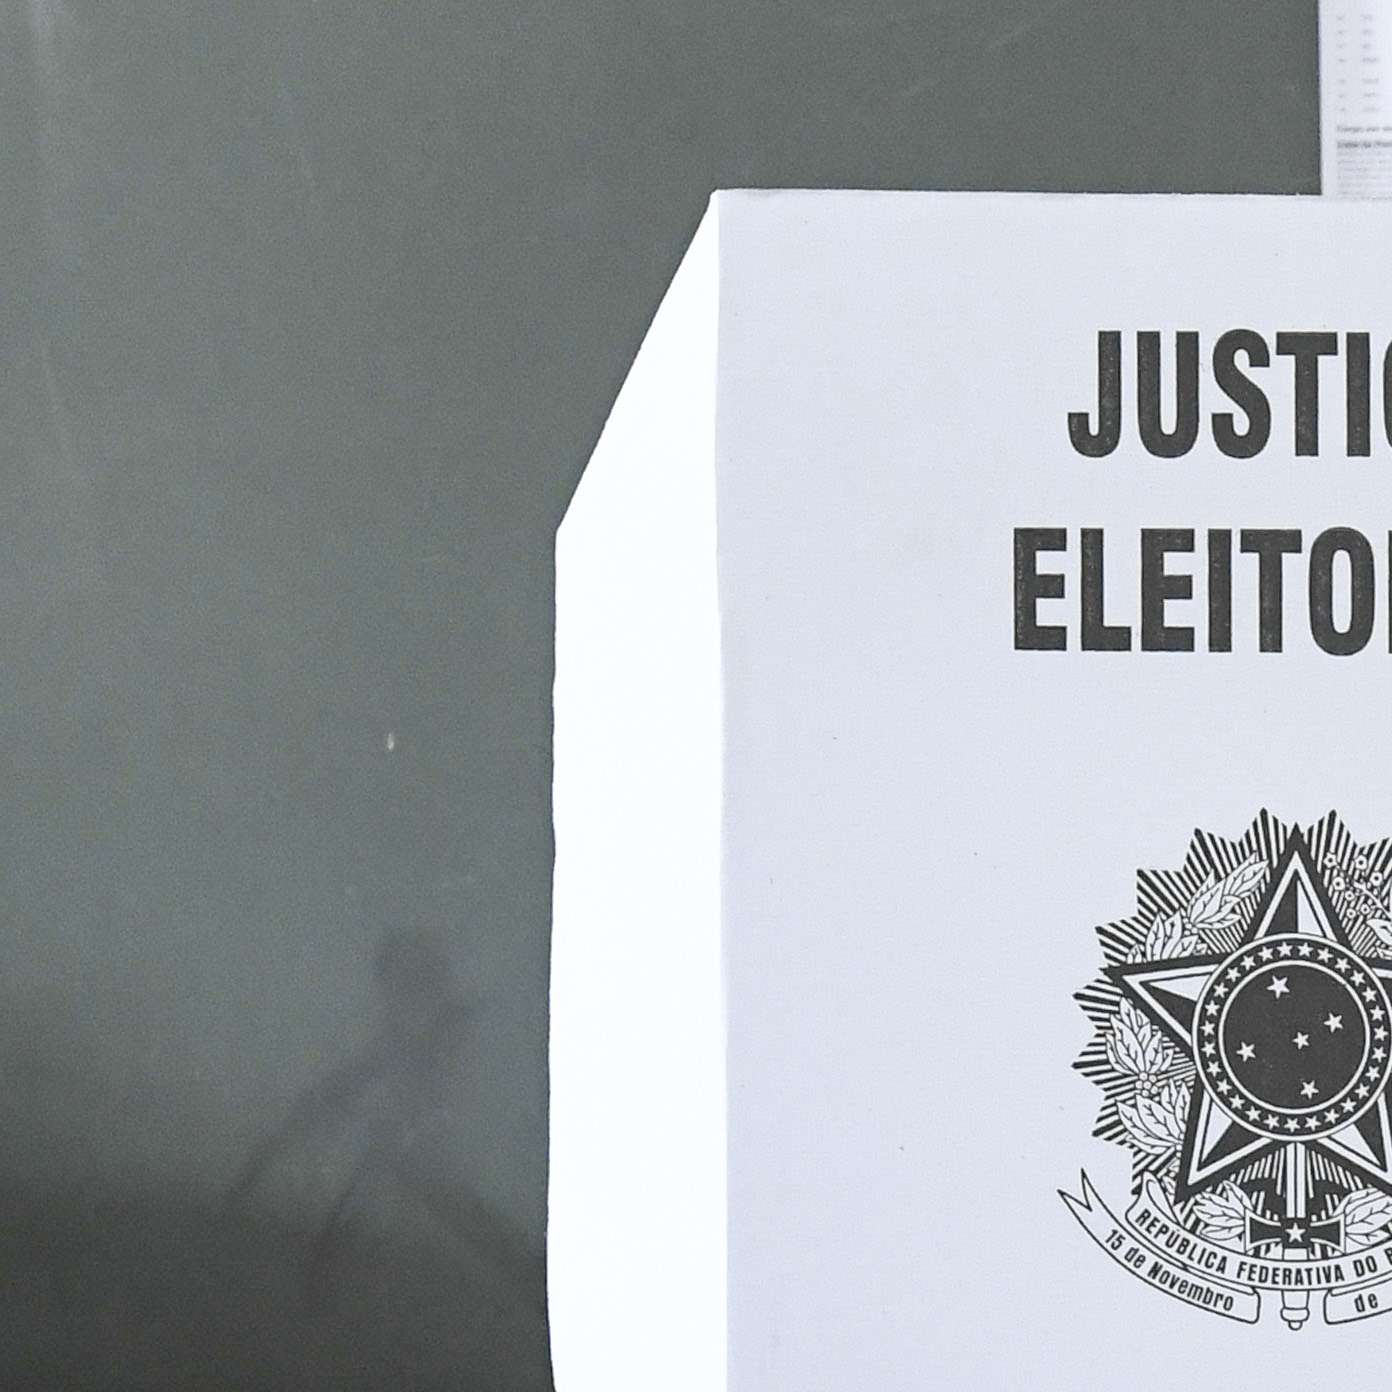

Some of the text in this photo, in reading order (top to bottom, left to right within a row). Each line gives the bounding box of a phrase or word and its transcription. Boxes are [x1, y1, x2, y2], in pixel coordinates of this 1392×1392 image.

[1104, 1228, 1234, 1312] 15 de Novembro
[1134, 1208, 1228, 1275] REPÚBLICA
[1236, 1260, 1346, 1286] FEDERATIVA
[1352, 1255, 1378, 1278] DO
[1353, 1292, 1379, 1313] de
